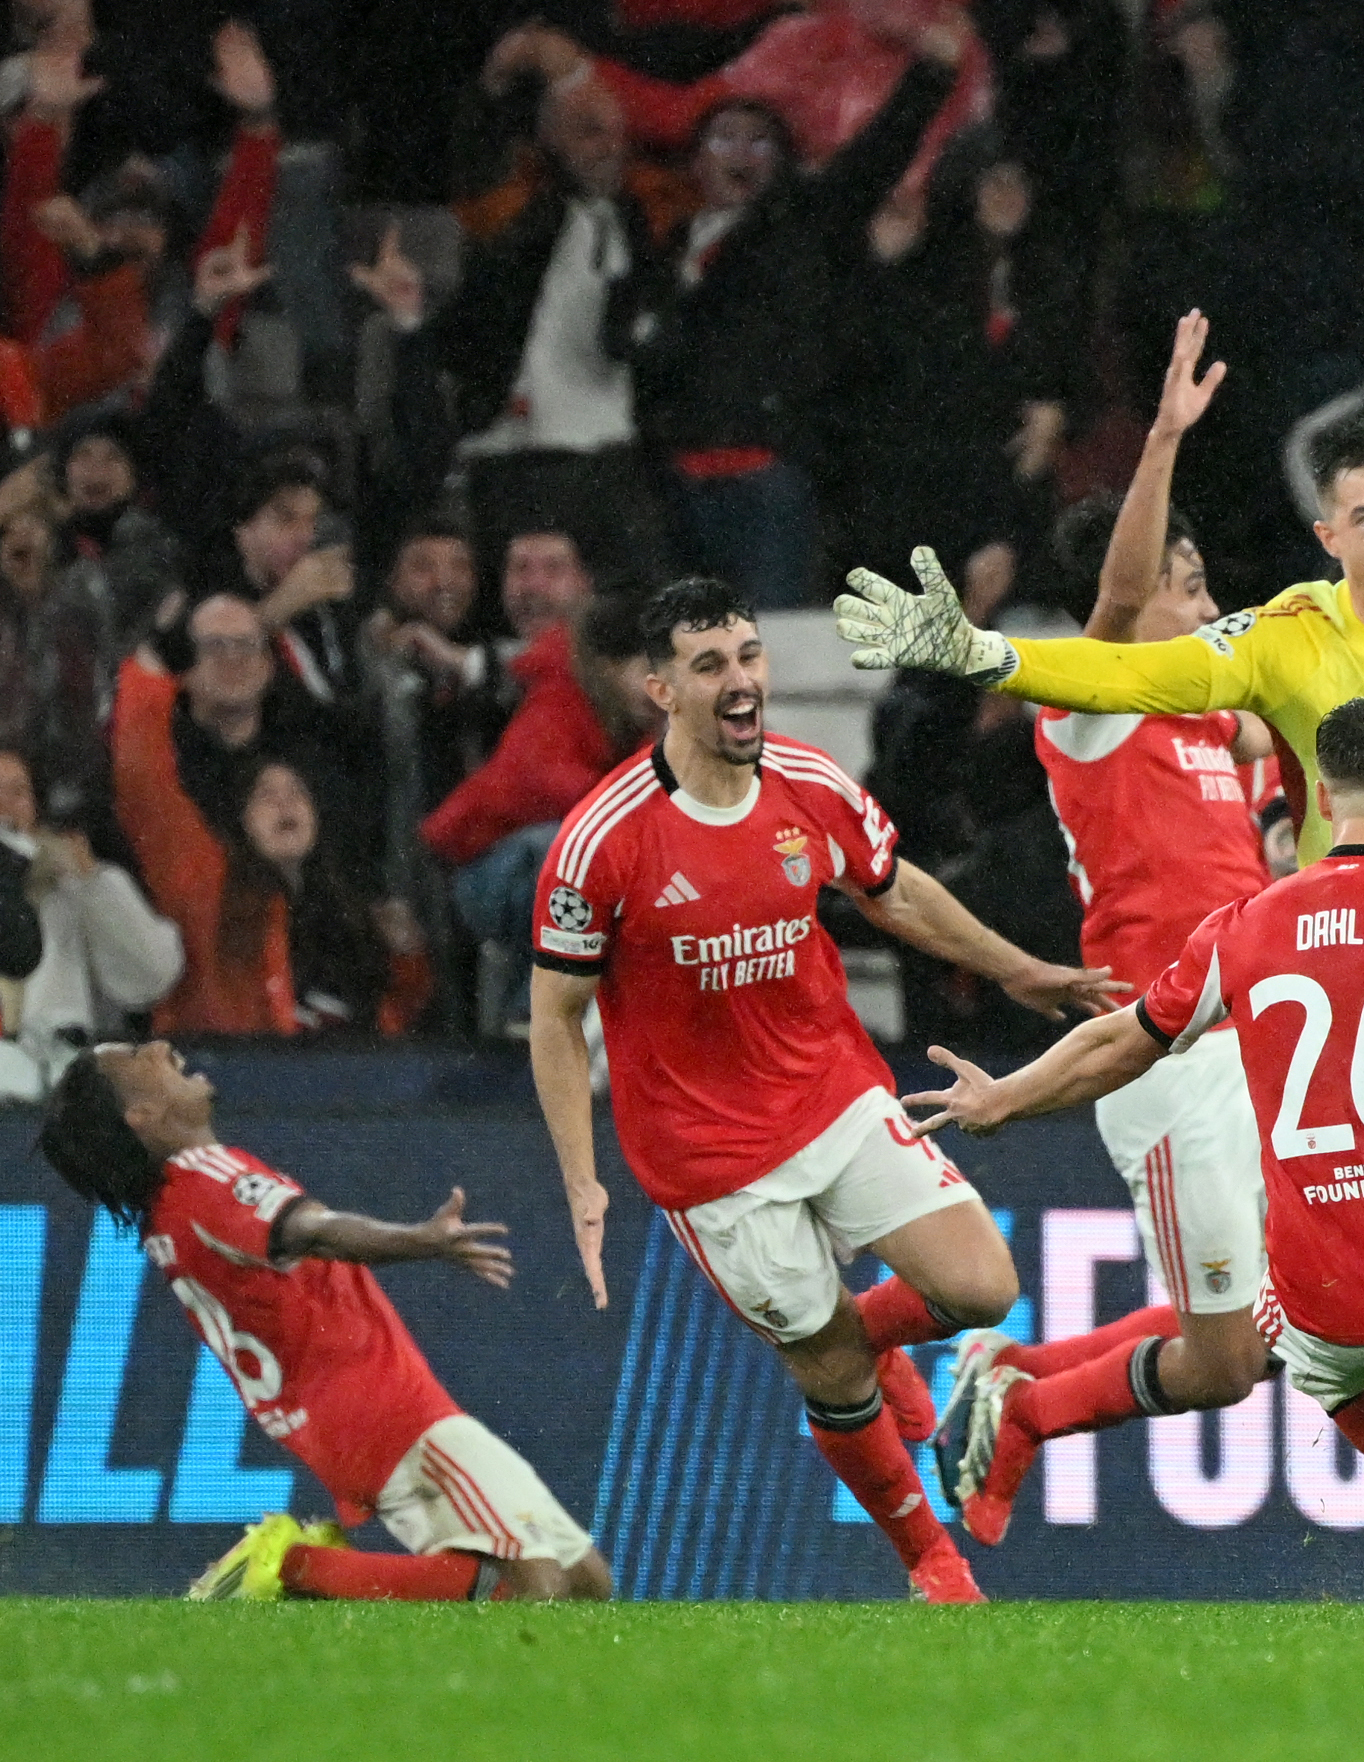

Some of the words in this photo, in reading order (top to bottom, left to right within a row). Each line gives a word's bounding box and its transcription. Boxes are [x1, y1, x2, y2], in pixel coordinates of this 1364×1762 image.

[671, 913, 813, 967] Emirates
[1296, 908, 1364, 951] DAHL
[700, 966, 730, 992] FLY
[733, 949, 796, 986] BETTER
